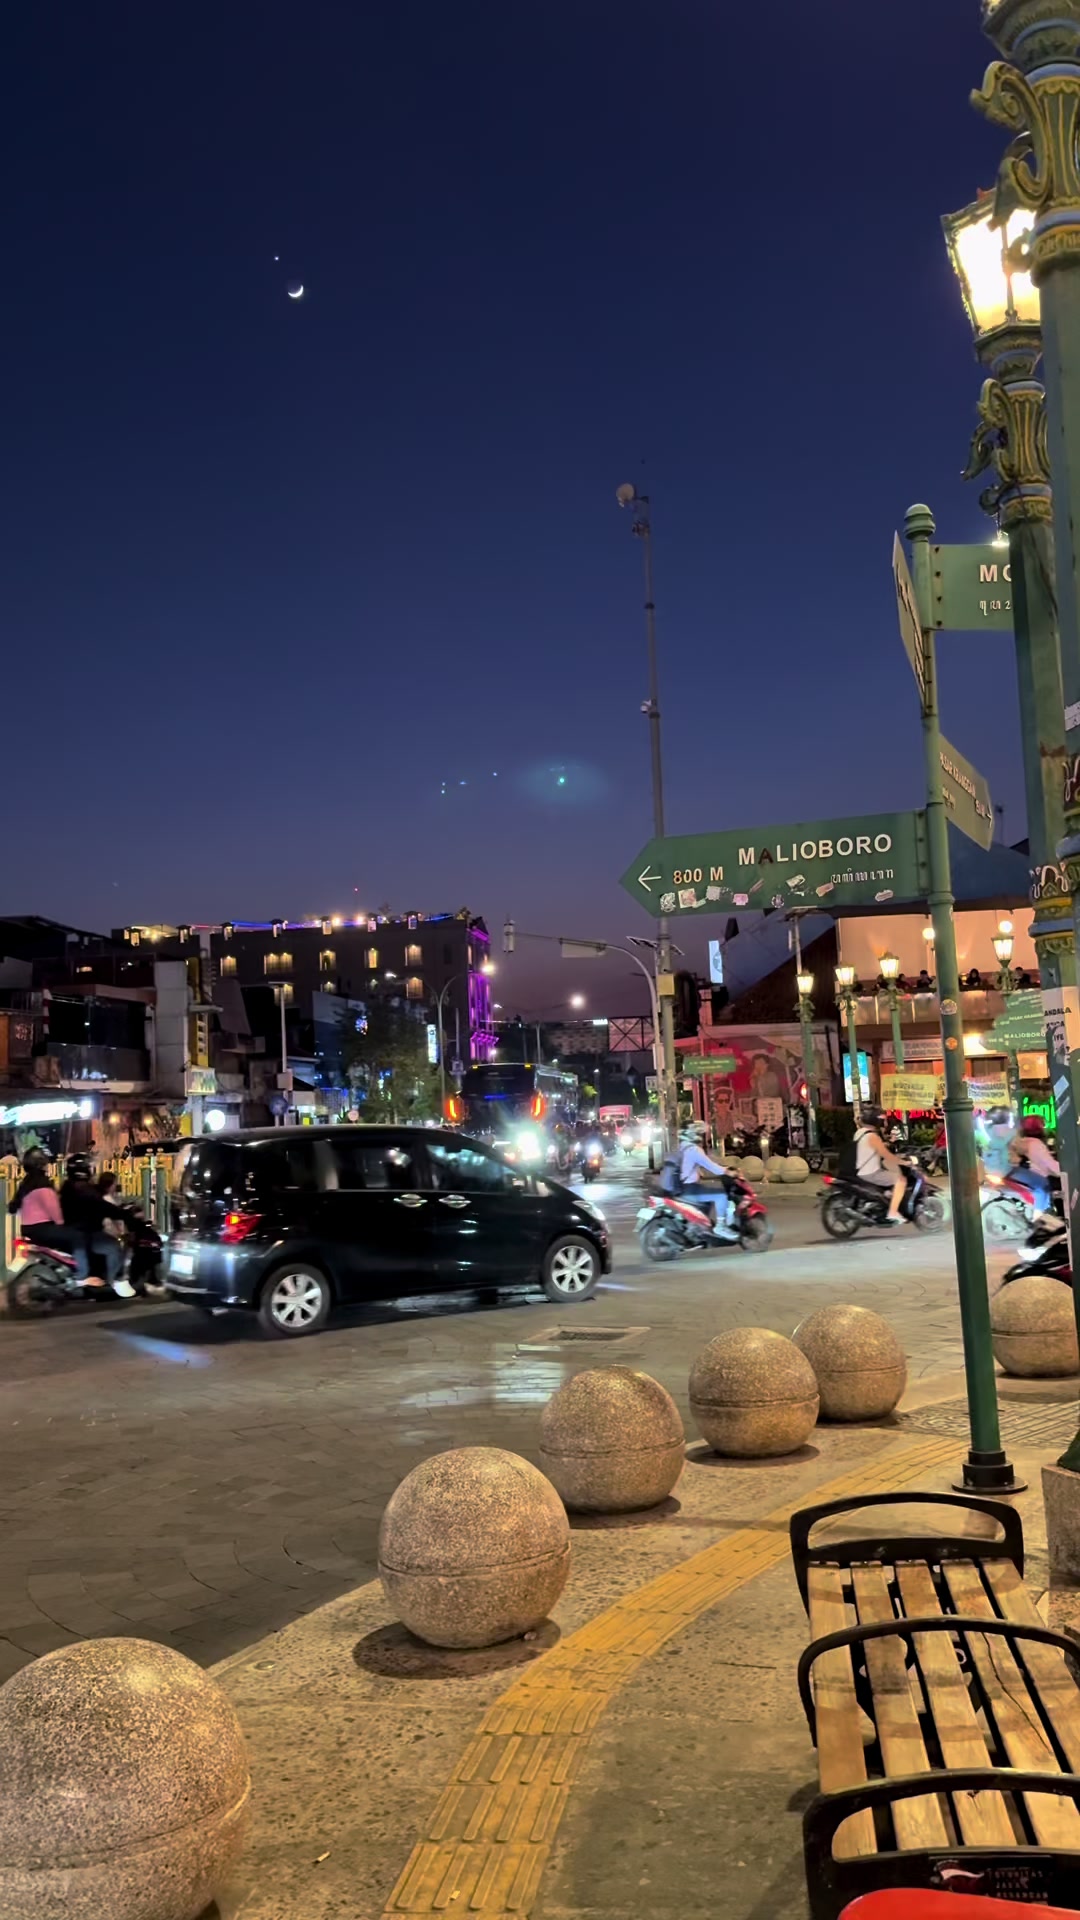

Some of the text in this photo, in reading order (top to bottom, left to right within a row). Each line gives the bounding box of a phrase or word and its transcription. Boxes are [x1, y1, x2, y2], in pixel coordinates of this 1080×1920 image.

[738, 833, 892, 866] MALIOBORO
[673, 866, 724, 885] 800 M
